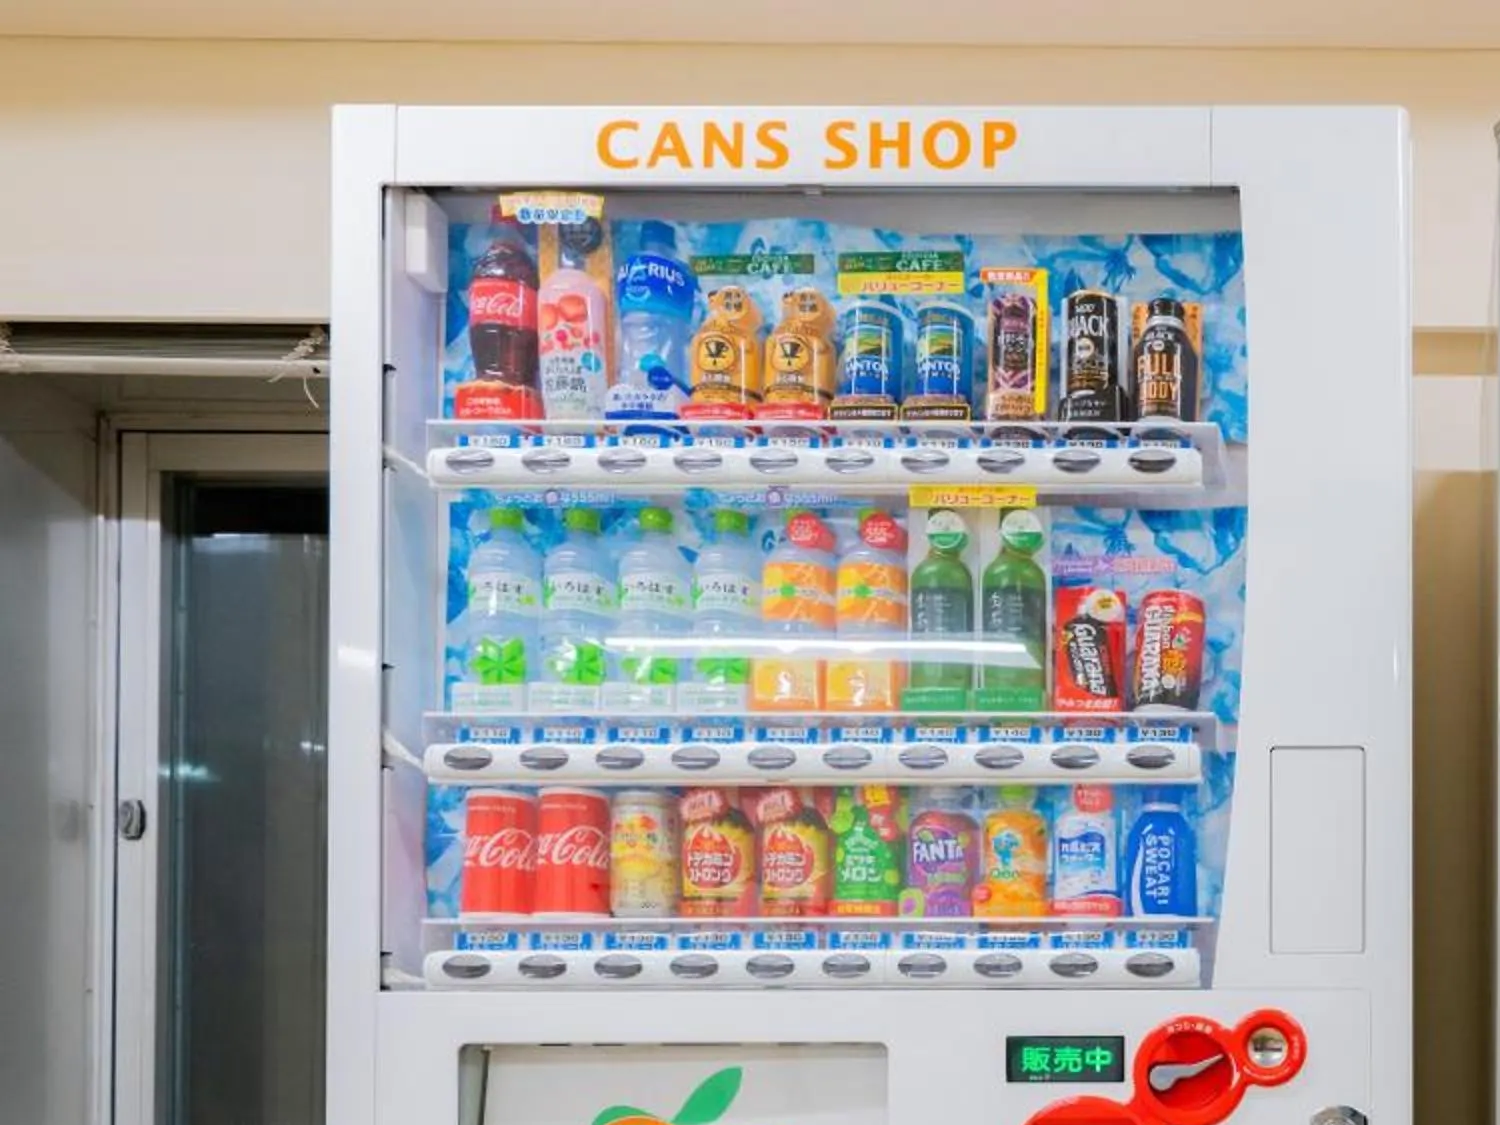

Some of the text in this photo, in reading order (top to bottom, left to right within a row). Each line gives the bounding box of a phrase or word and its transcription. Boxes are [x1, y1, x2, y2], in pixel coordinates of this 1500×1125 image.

[596, 119, 1018, 171] CANS SHOP
[480, 580, 523, 594] ろはす
[913, 838, 965, 865] FANTA
[1145, 833, 1158, 897] SWEAT
[1157, 833, 1172, 905] POCARI
[1021, 1046, 1113, 1074] 販売中
